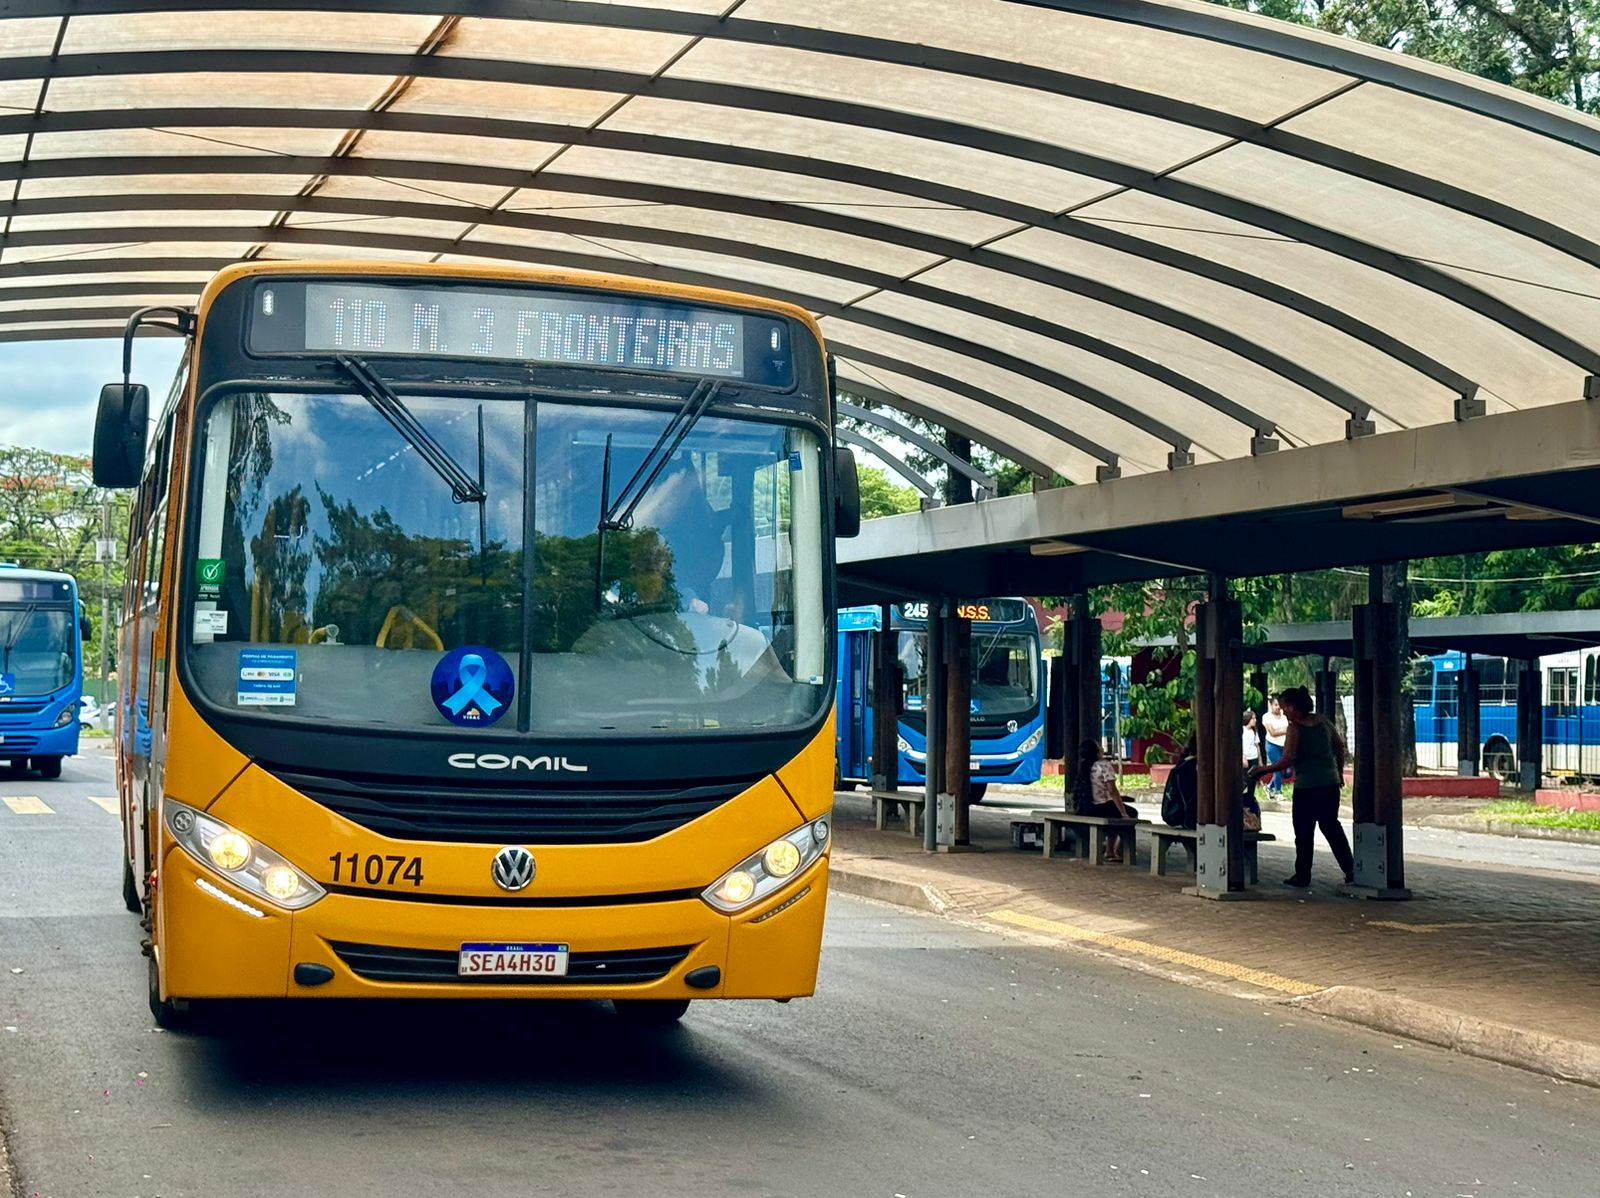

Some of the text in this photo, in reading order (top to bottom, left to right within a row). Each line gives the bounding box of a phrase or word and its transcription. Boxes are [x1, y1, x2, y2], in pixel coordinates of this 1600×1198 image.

[329, 297, 736, 369] 110 M. 3 FRONTEIRAS
[904, 602, 929, 618] 245
[448, 753, 588, 771] COMIL
[329, 852, 424, 886] 11074
[469, 953, 556, 972] SEA4H30
